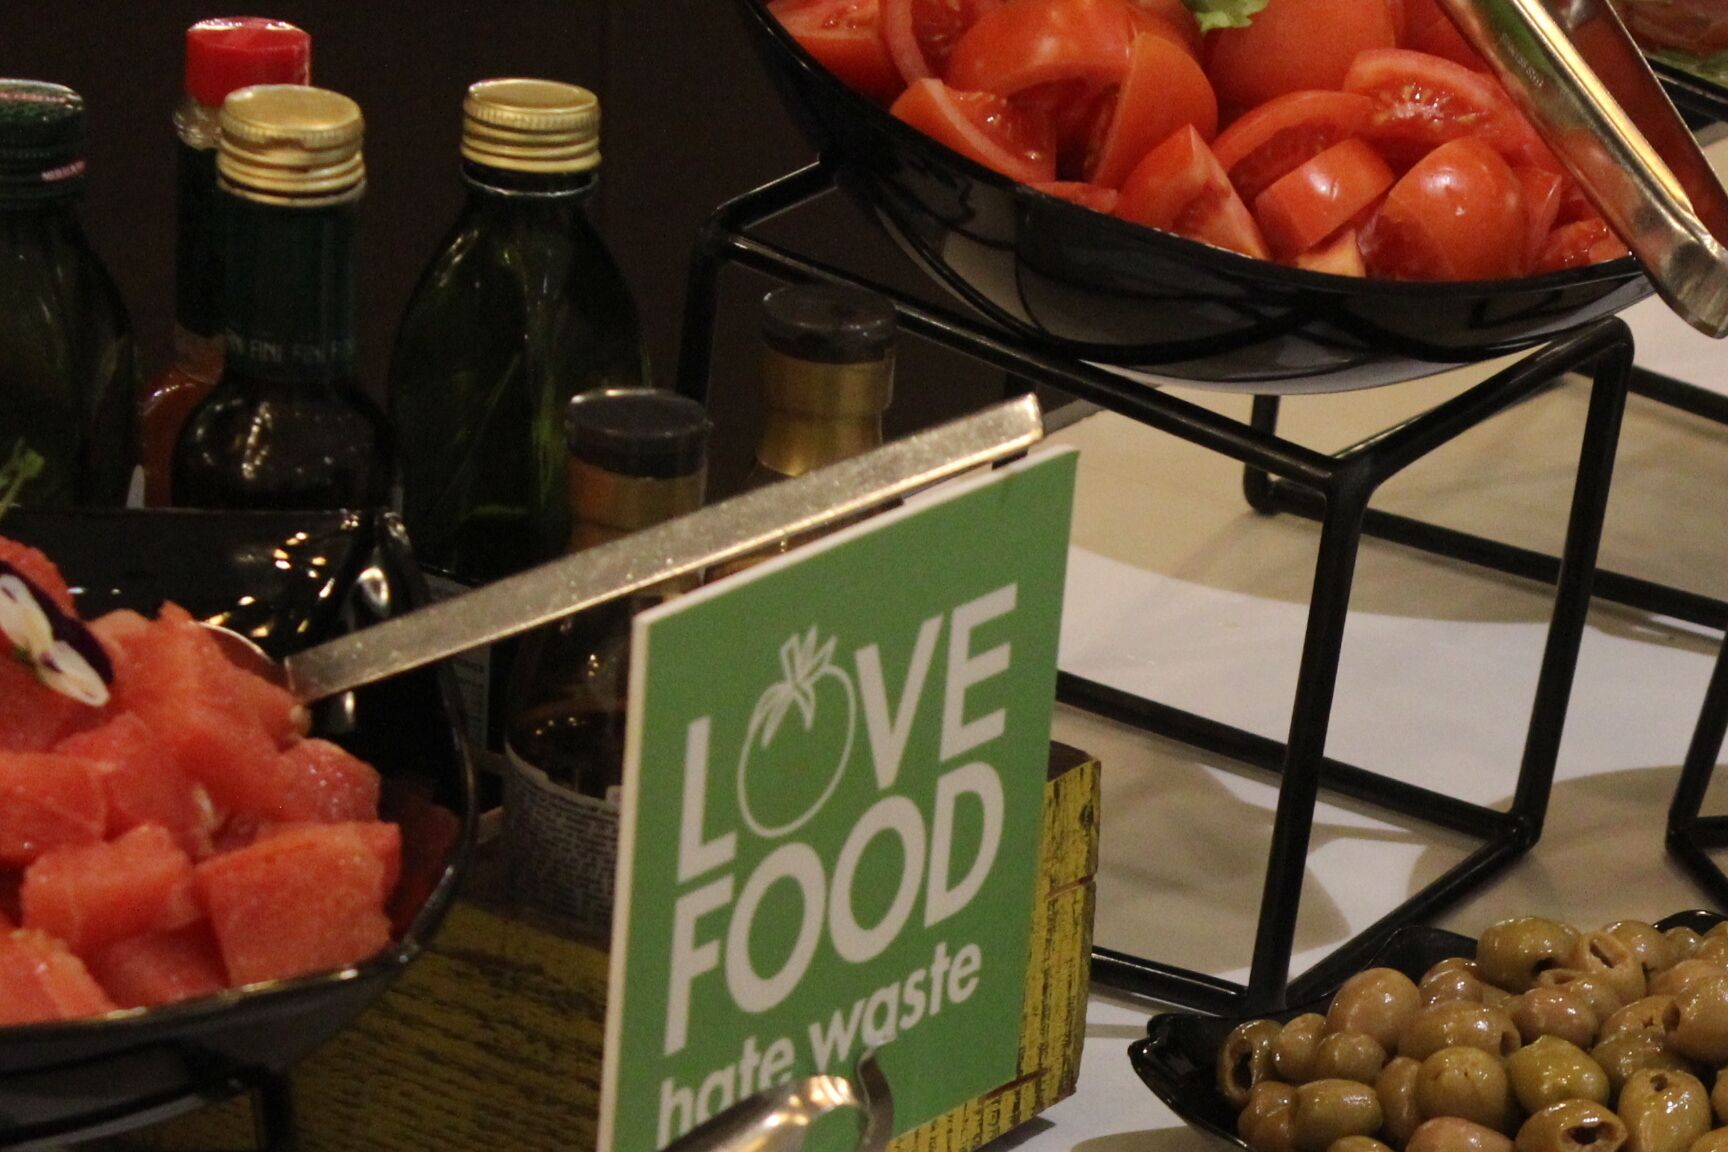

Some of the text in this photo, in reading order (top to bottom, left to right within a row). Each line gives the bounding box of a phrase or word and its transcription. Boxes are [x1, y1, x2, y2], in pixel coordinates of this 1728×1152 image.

[677, 583, 1018, 883] LOVE
[657, 941, 983, 1151] hate waste
[664, 761, 1005, 1057] FOOD
